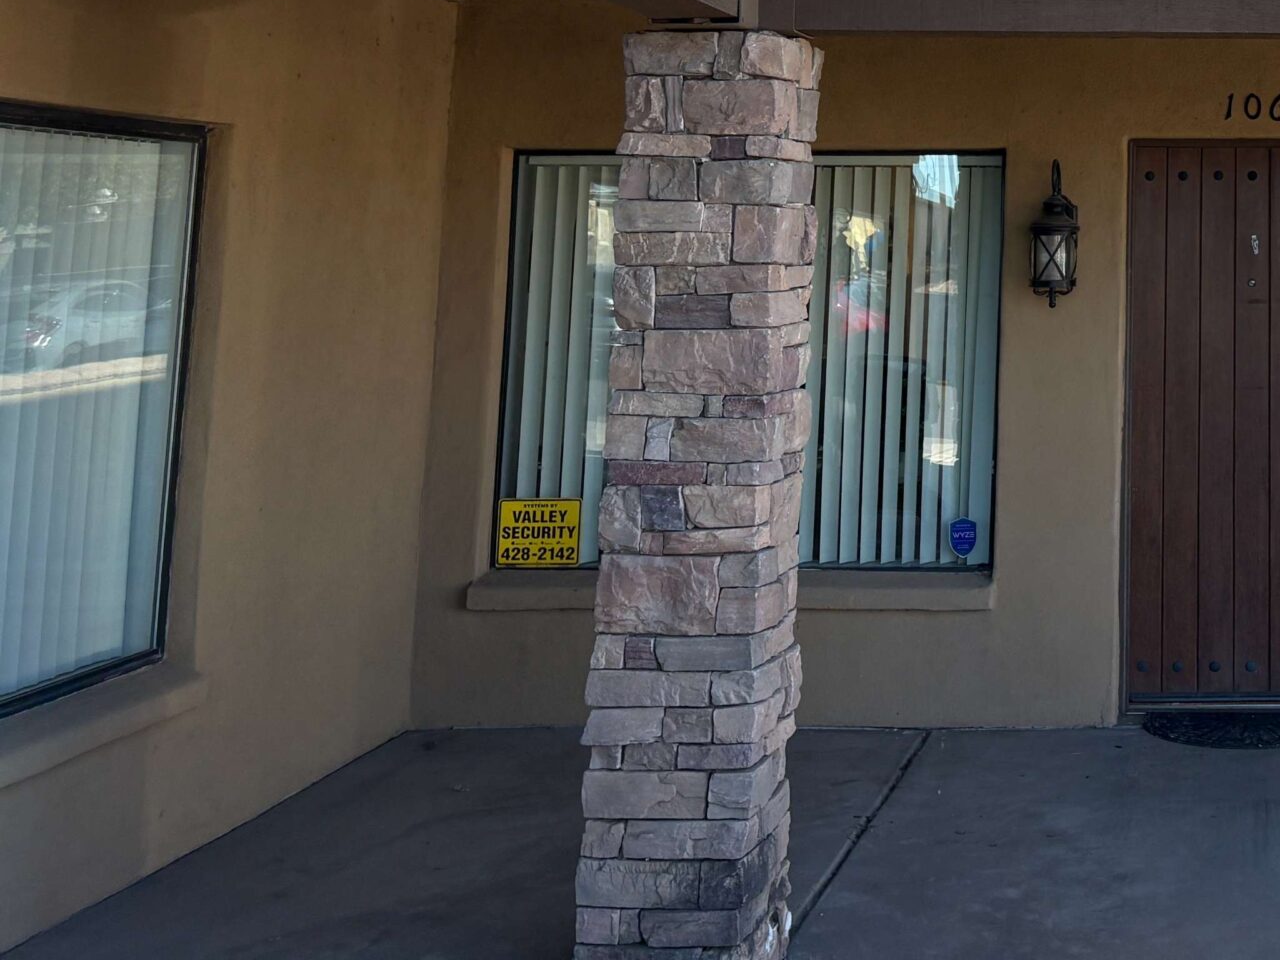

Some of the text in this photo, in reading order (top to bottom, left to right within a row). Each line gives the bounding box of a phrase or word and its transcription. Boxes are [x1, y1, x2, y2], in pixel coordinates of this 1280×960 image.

[512, 510, 568, 523] VALLEY
[502, 526, 576, 539] SECURITY
[501, 546, 575, 560] 428-2142
